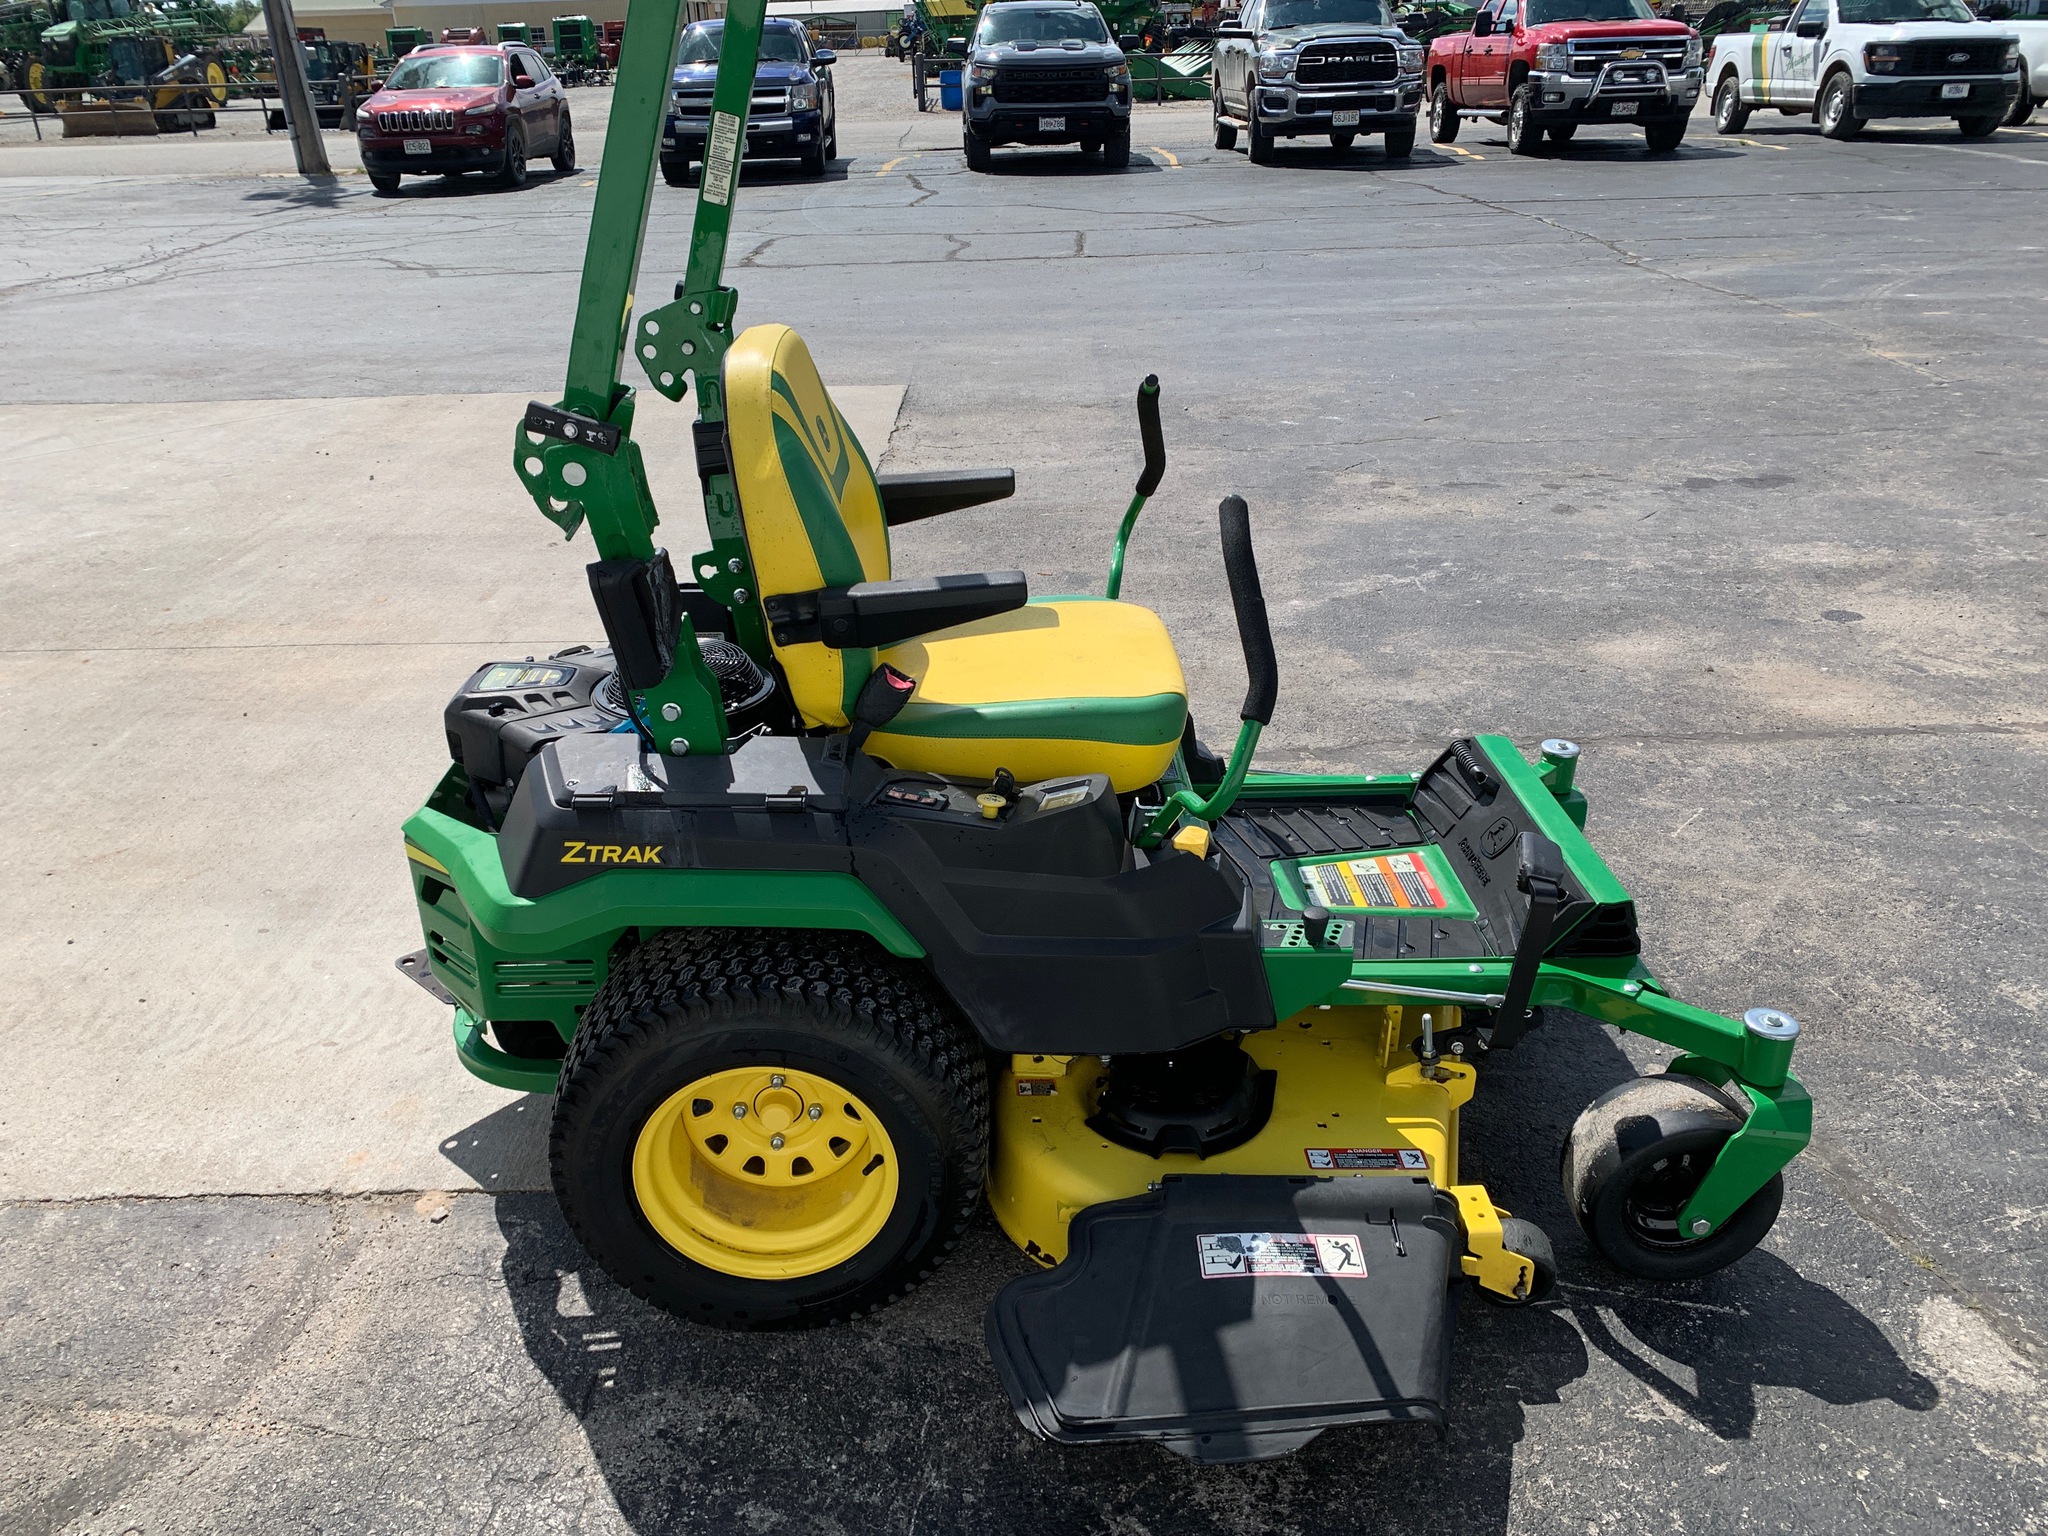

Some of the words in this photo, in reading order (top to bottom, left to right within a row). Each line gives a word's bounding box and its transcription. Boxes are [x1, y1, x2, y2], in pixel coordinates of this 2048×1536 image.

[561, 842, 663, 863] ZTRAK
[1262, 1294, 1290, 1305] NOT
[1296, 1294, 1357, 1306] REMOE
